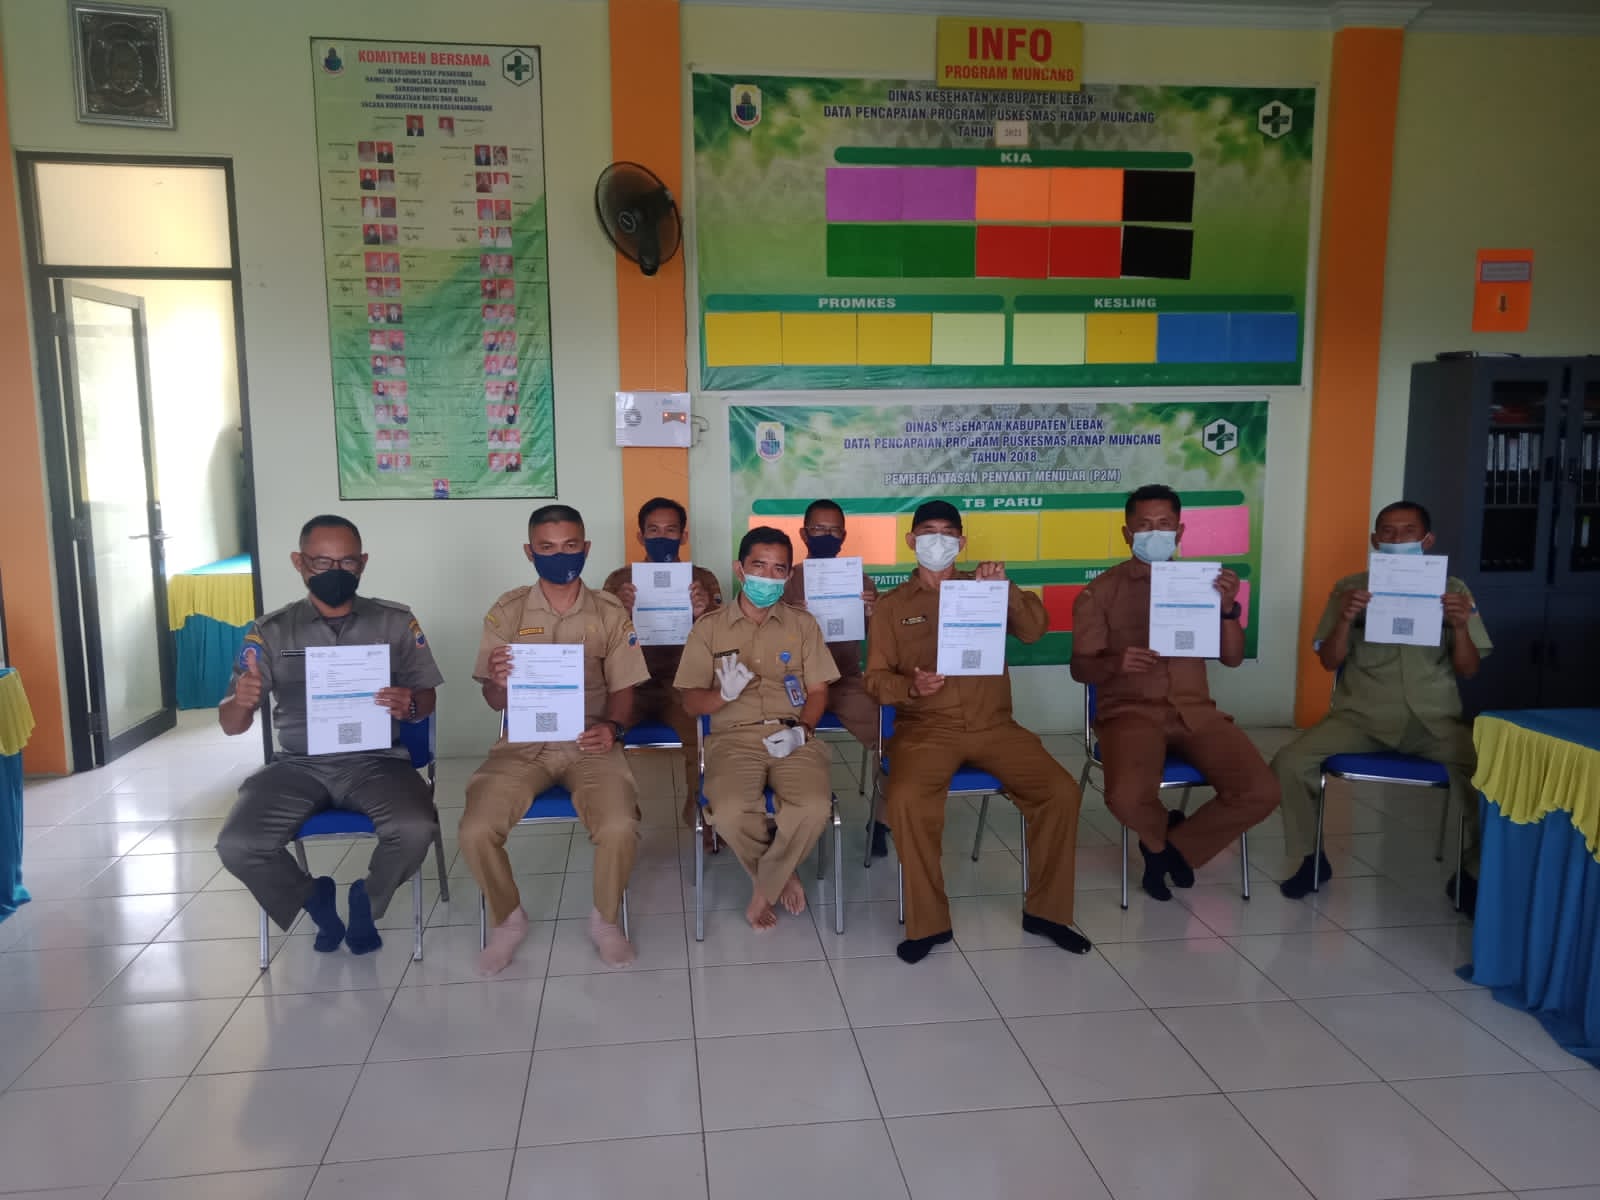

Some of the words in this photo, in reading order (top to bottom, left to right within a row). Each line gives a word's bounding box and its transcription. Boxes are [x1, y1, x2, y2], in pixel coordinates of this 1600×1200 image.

[968, 26, 1052, 63] INFO
[358, 50, 426, 64] KOMITMEN
[430, 52, 490, 66] BERSAMA
[945, 65, 1008, 80] PROGRAM
[1012, 67, 1075, 82] MUNCANG
[888, 89, 922, 102] DINAS
[926, 90, 988, 103] KESEHATAN
[992, 92, 1056, 104] KABUPATEN
[1060, 93, 1094, 105] LEBAK
[824, 106, 851, 118] DATA
[855, 106, 928, 119] PENCAPAIAN
[931, 108, 986, 120] PROGRAM
[990, 109, 1057, 121] PUSKESMAS
[1060, 111, 1097, 122] RANAP
[1100, 112, 1155, 123] MUNCANG
[958, 126, 994, 137] TAHUN
[1000, 152, 1032, 163] KIA
[818, 297, 896, 309] PROMKES
[1094, 298, 1157, 309] KESLING
[905, 421, 938, 433] DINAS
[942, 420, 1002, 432] KESEHATAN
[1005, 419, 1066, 431] KABUPATEN
[1070, 419, 1103, 430] LEBAK
[844, 438, 870, 449] DATA
[874, 437, 942, 449] PENCAPAIAN
[945, 436, 999, 448] PROGRAM
[1003, 435, 1066, 446] PUSKESMAS
[1070, 434, 1105, 446] RANAP
[1109, 434, 1160, 445] MUNCANG
[972, 451, 1006, 463] TAHUN
[1010, 451, 1036, 462] 2018
[884, 472, 977, 486] PEMBERANTASAN
[981, 471, 1031, 484] PENYAKIT
[1035, 469, 1086, 482] MENULAR
[1089, 469, 1121, 483] (P2M)
[963, 498, 985, 508] TB
[993, 497, 1042, 508] PARU
[868, 574, 909, 585] EPATITIS
